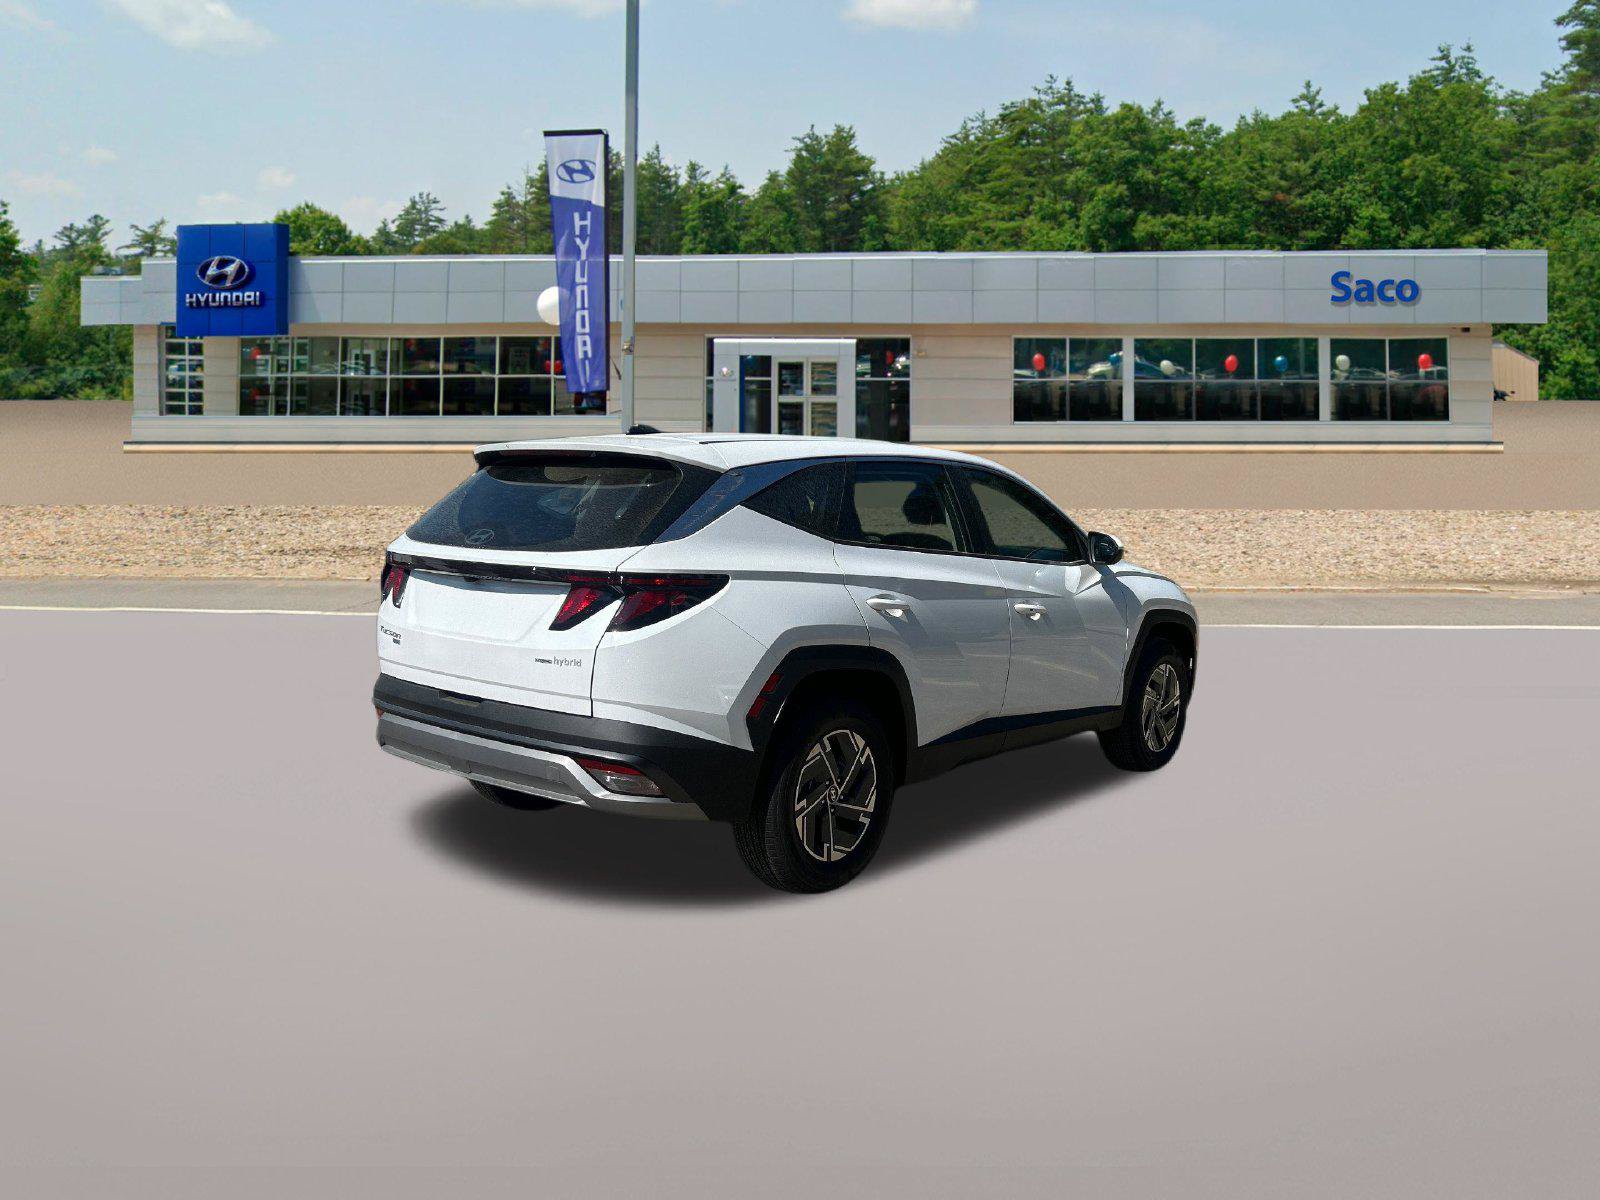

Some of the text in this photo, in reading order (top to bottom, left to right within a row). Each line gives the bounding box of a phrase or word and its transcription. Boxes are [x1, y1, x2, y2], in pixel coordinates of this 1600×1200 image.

[573, 210, 594, 383] HYUNDAI
[1330, 270, 1420, 303] Saco
[185, 291, 261, 307] HYUNDAI
[553, 655, 582, 667] hybrid
